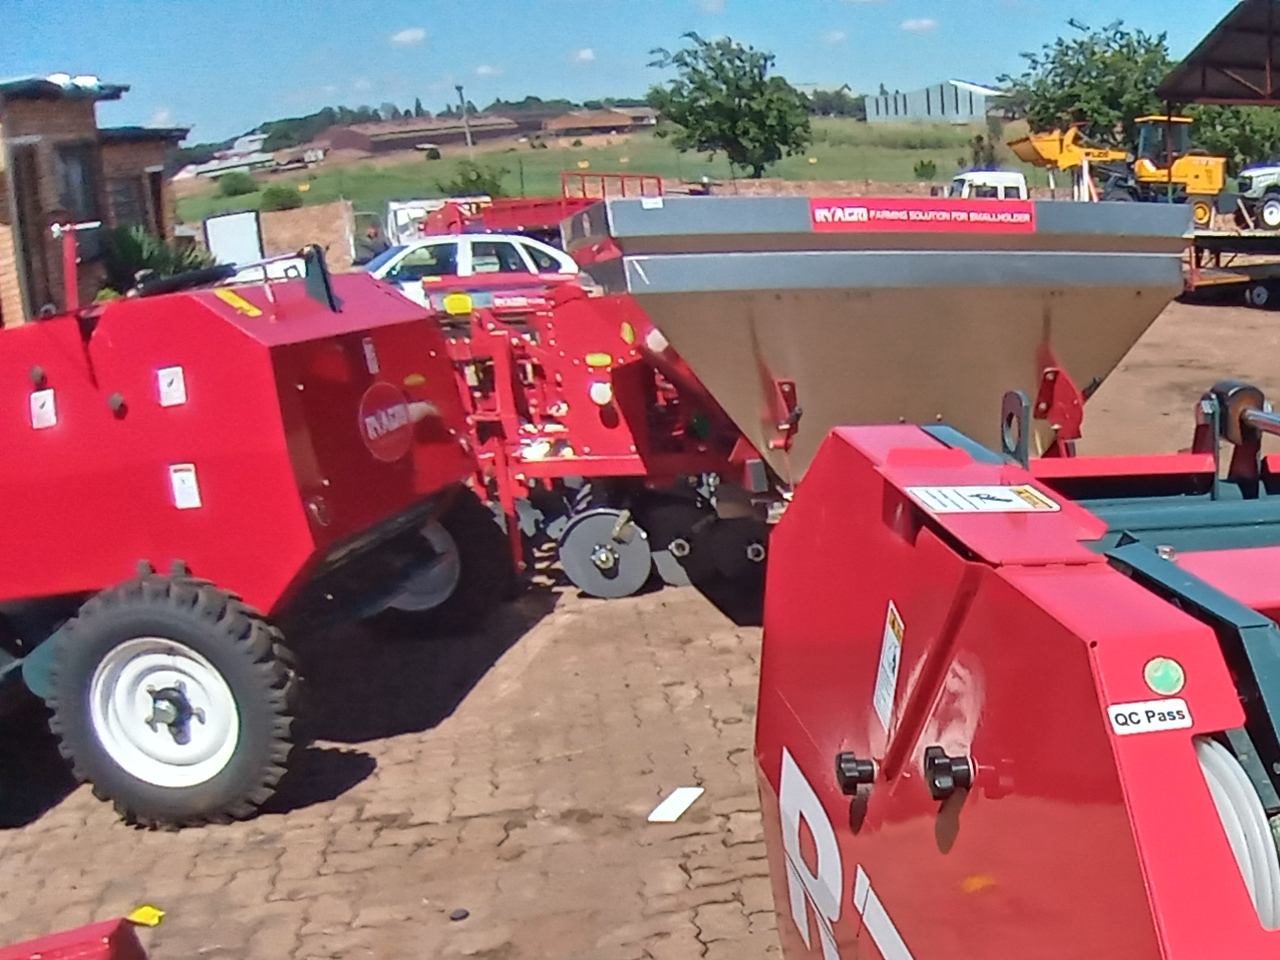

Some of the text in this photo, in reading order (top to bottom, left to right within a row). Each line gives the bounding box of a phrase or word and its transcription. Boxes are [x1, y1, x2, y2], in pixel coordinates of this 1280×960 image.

[814, 207, 1031, 223] RYAGRI FARMING SOLUTION FOR SMALLHOLDER
[1114, 709, 1186, 726] QC Pass
